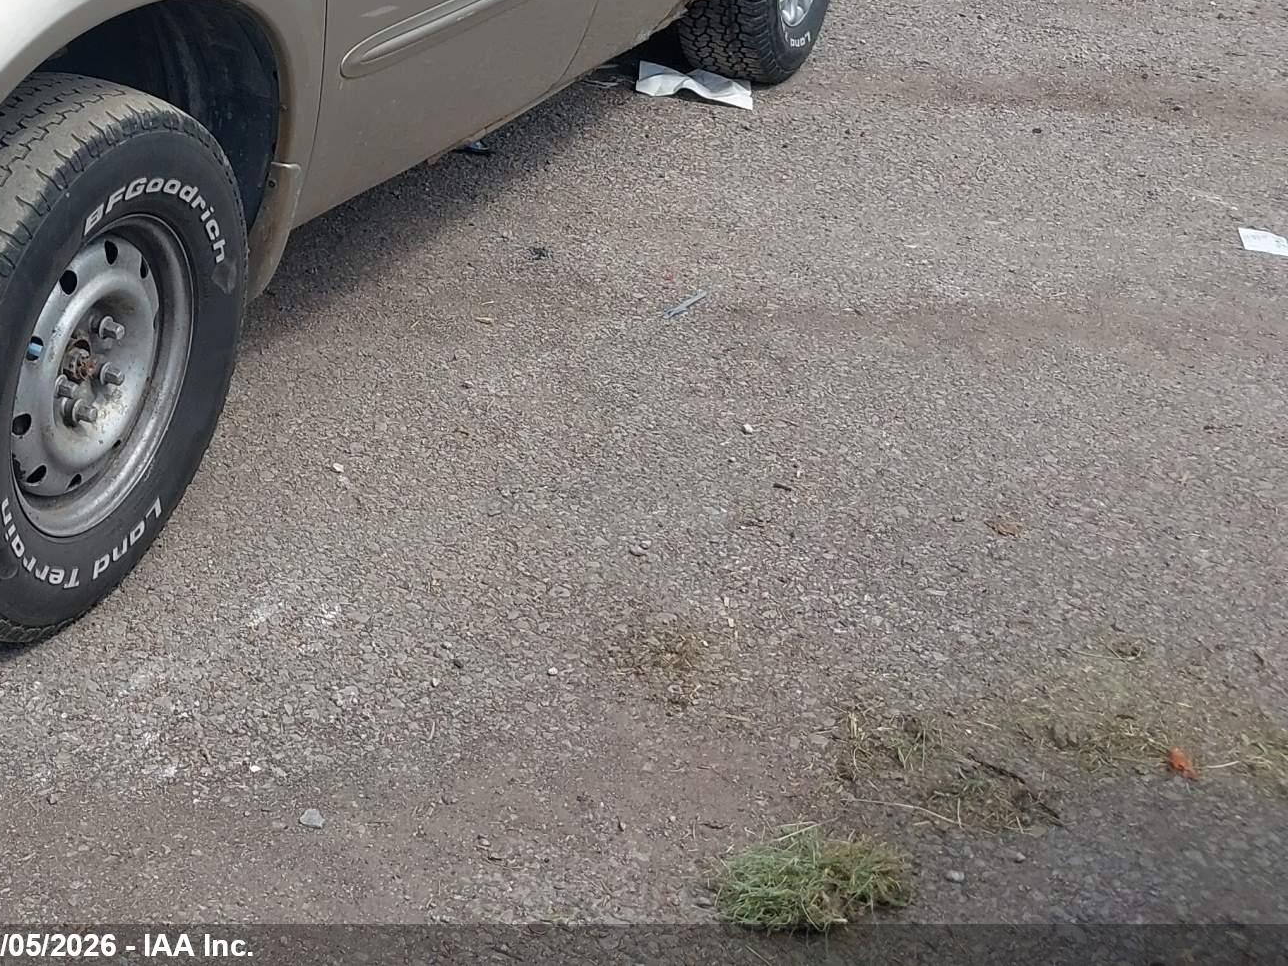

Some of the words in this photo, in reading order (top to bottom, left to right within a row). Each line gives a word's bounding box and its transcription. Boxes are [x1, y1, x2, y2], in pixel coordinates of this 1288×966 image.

[83, 176, 227, 264] BFGoodrich
[0, 497, 80, 590] Terrain
[92, 497, 163, 580] Land
